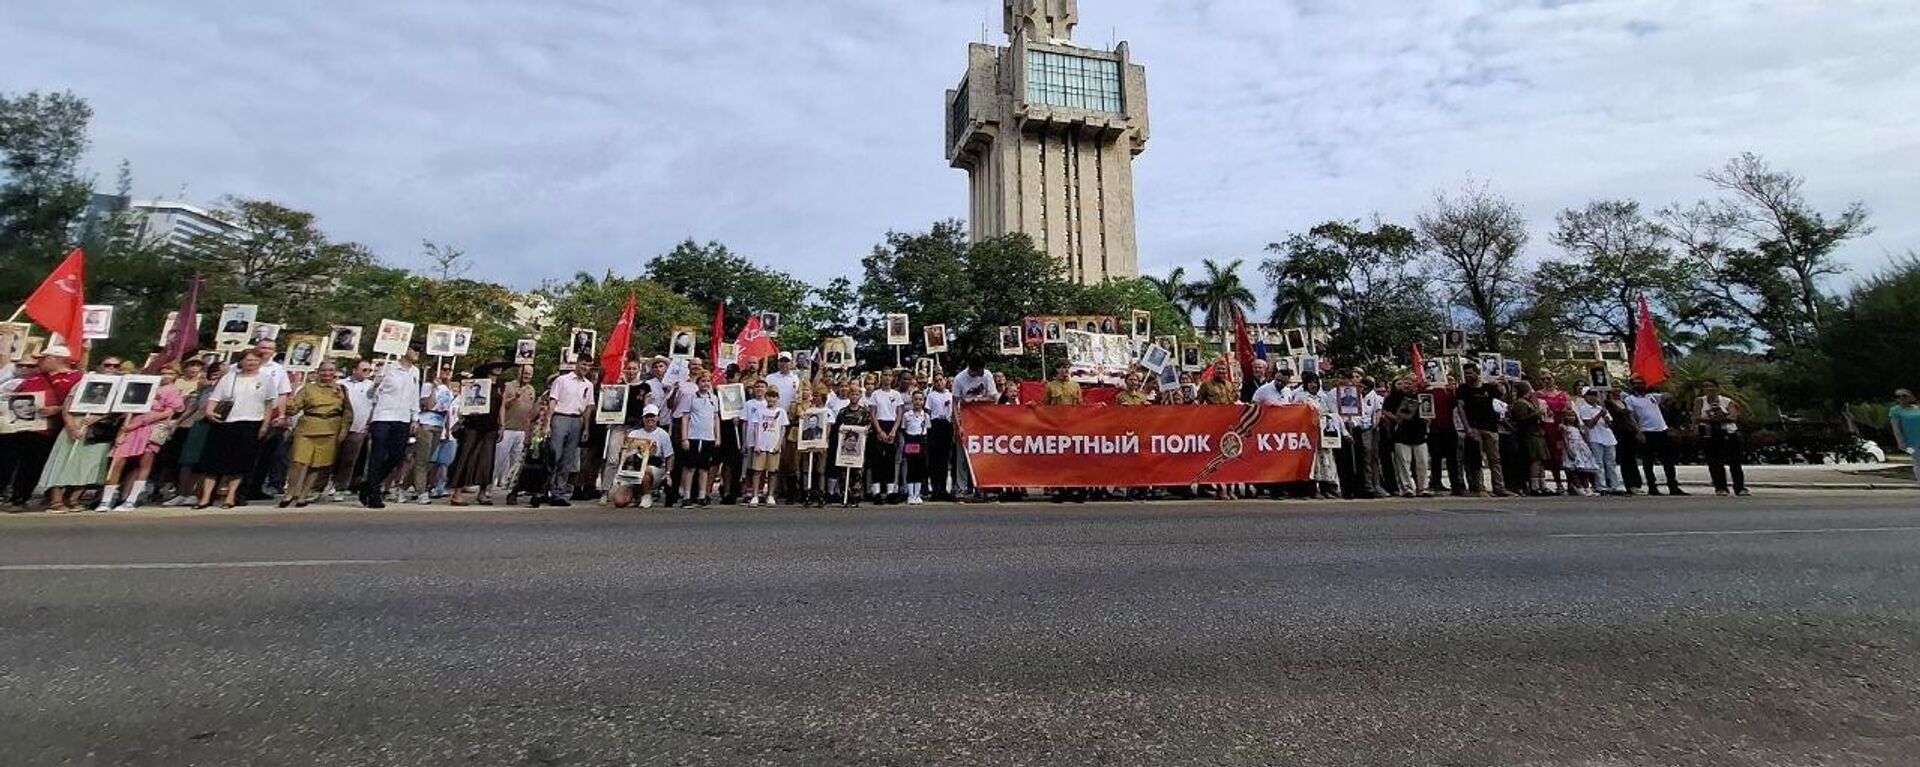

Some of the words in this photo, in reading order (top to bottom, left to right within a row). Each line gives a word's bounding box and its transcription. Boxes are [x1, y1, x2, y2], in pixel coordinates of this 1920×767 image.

[968, 430, 1139, 454] БЕССМЕРТНЫЙ
[1151, 434, 1211, 453] ПОЛК
[1257, 432, 1312, 451] КУБА
